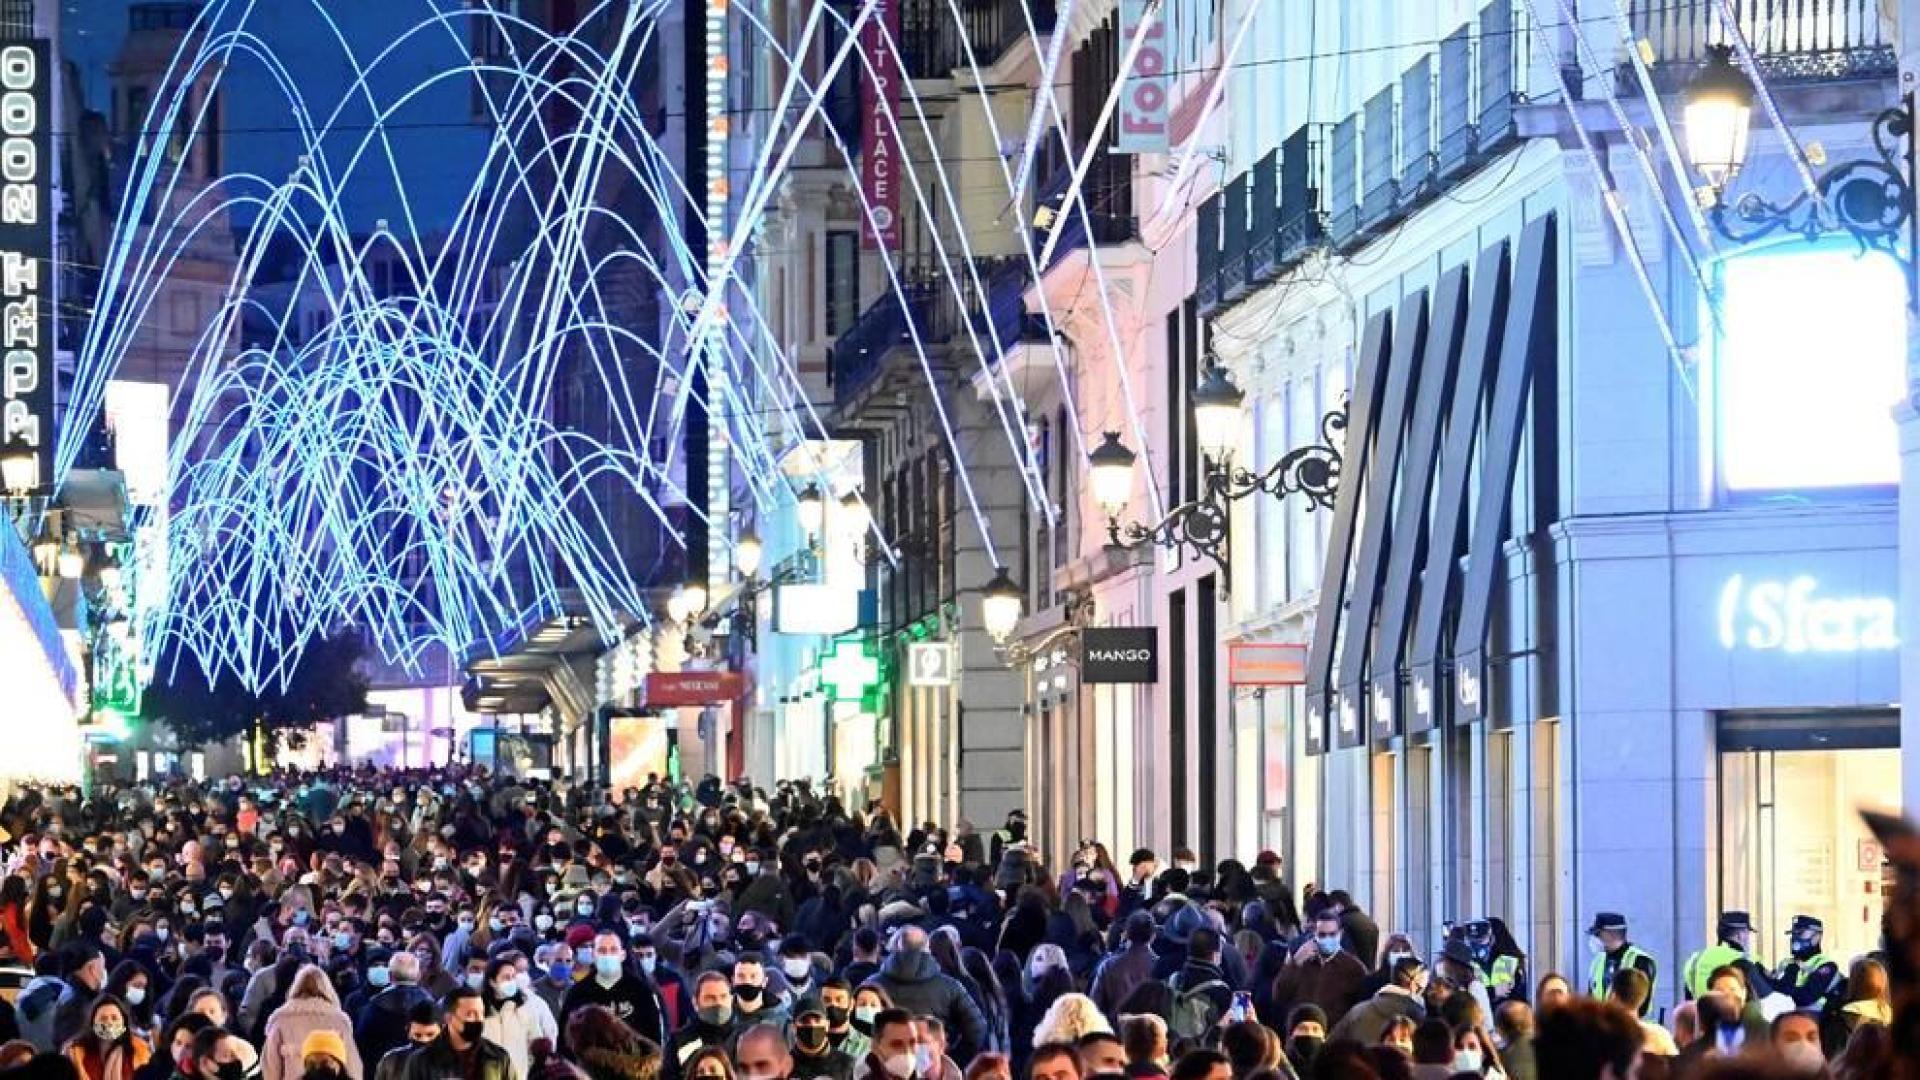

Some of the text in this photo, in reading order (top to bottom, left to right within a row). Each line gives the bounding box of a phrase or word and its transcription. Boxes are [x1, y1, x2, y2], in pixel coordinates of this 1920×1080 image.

[873, 75, 889, 199] PALACE
[1, 45, 39, 488] PORT 2000
[1088, 648, 1151, 662] MANGO
